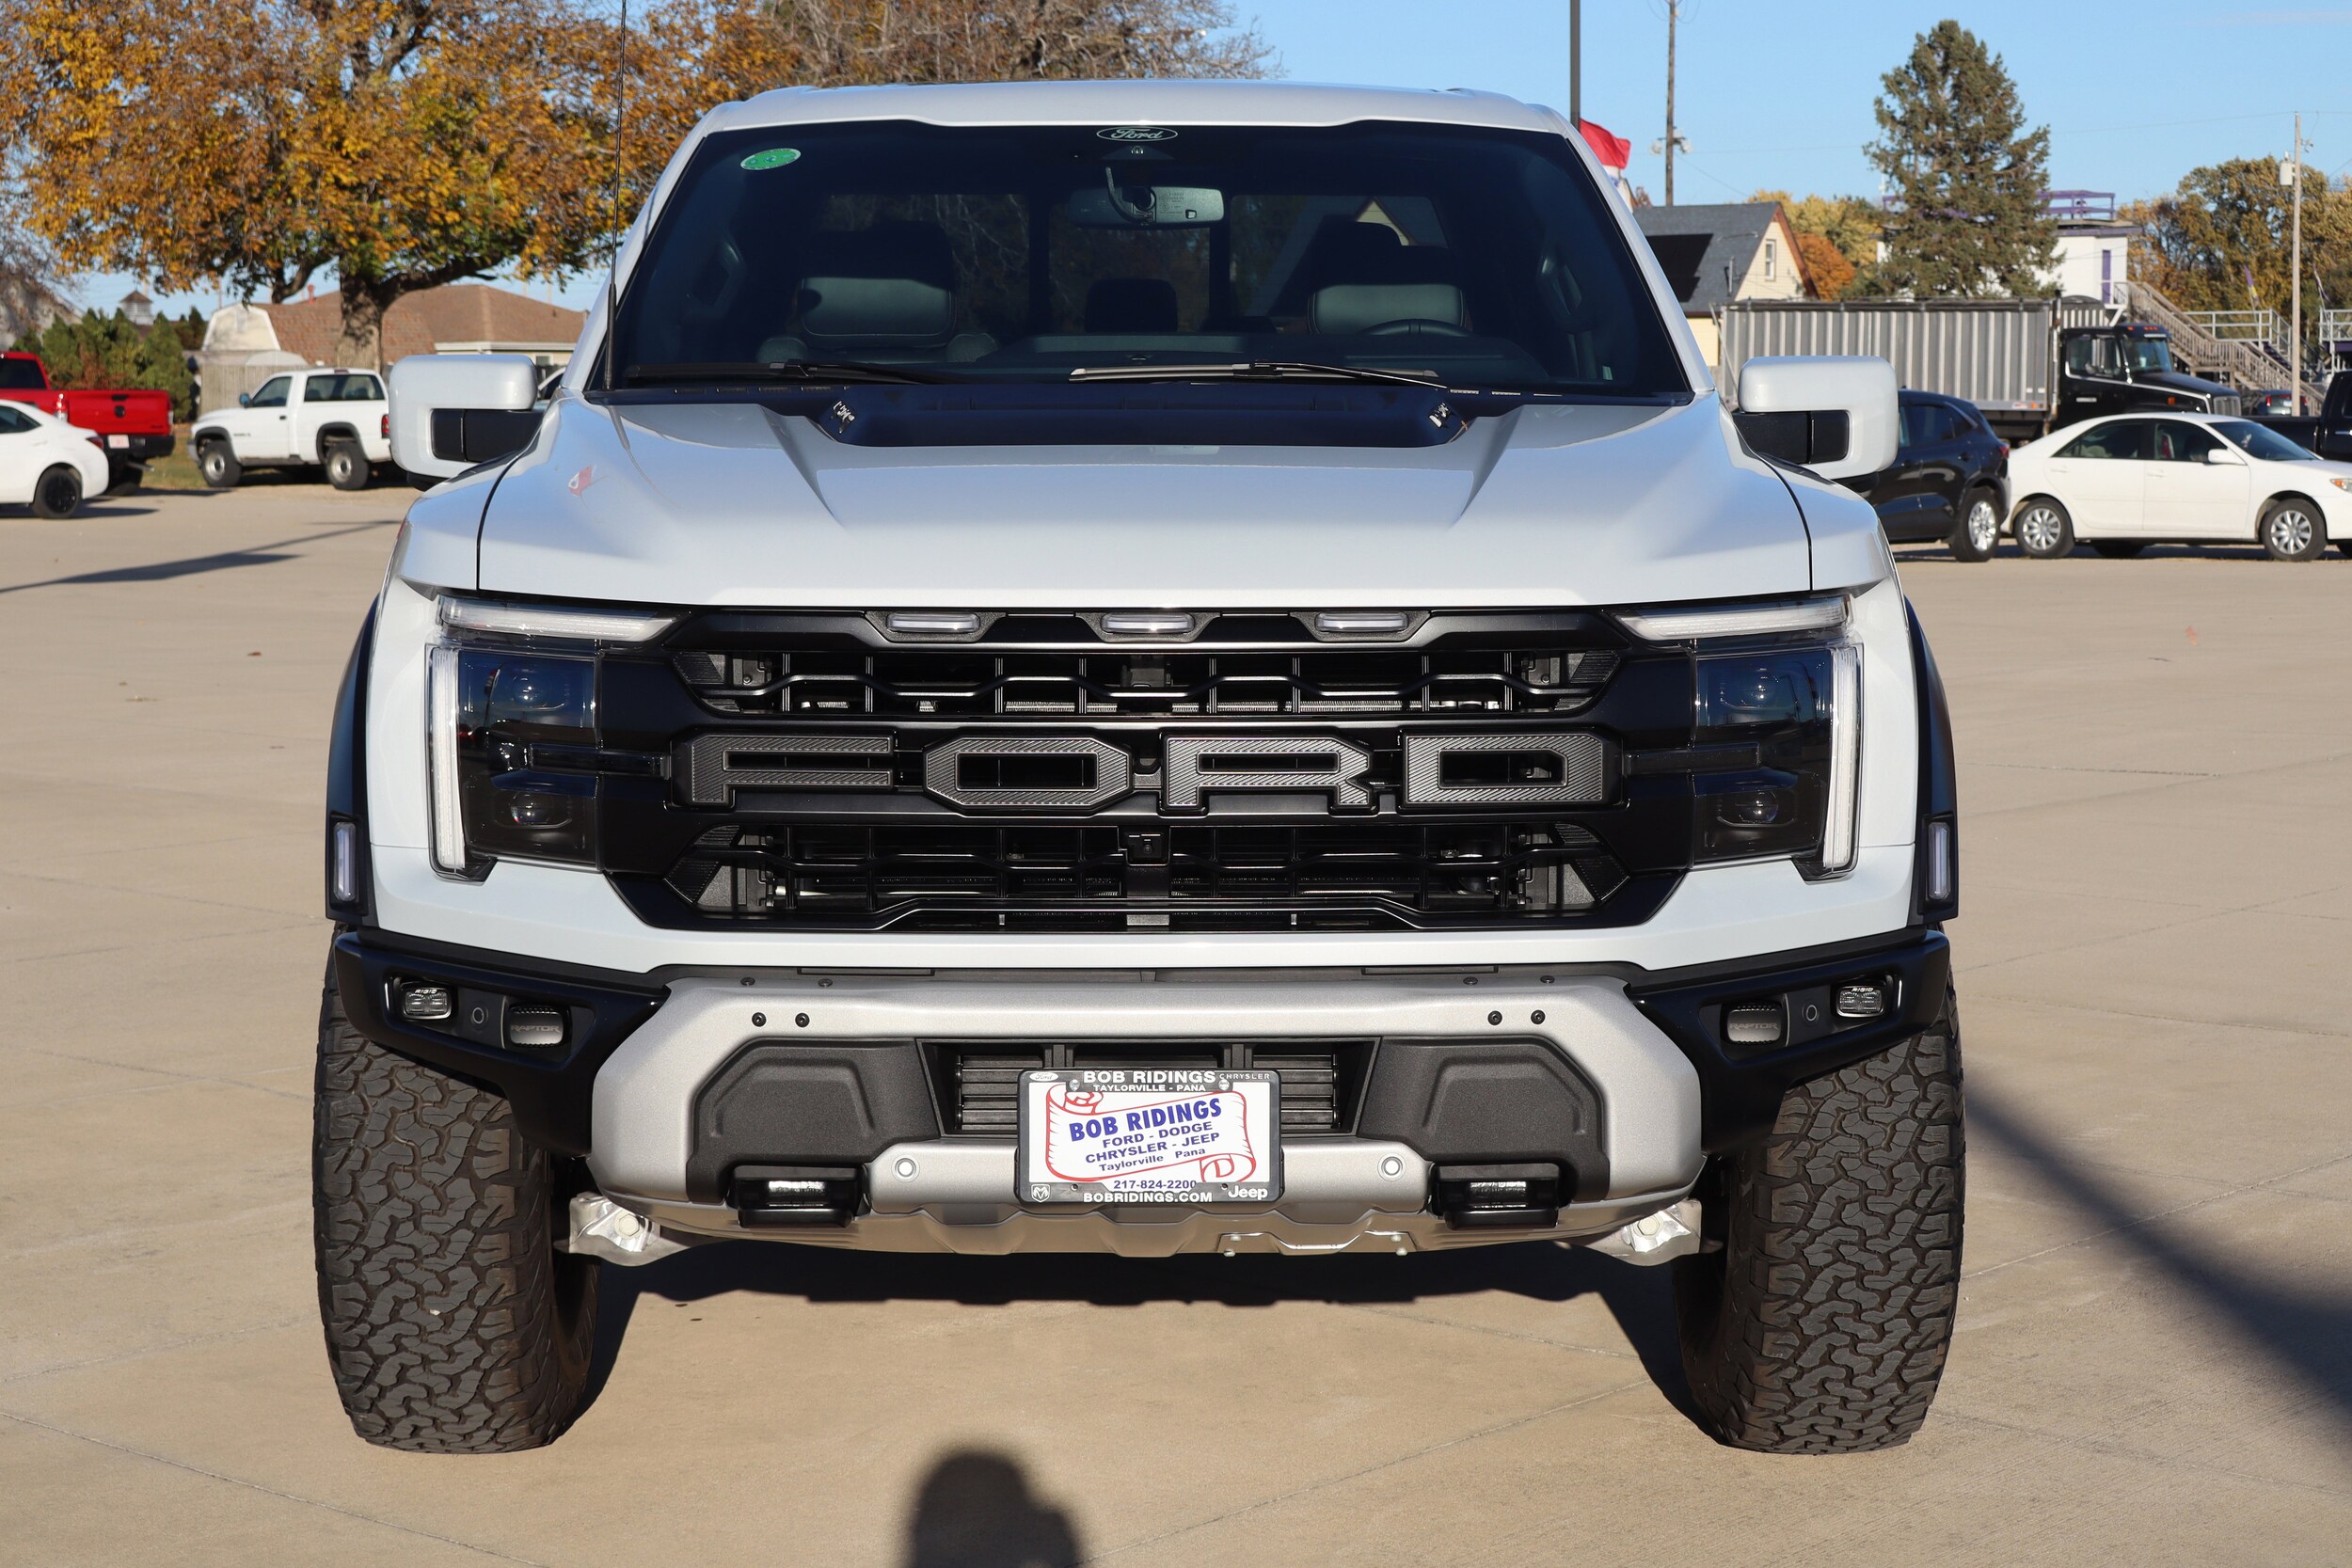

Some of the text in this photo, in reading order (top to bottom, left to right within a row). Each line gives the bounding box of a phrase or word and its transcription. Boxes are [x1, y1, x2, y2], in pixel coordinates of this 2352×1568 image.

[1110, 128, 1163, 139] Ford
[691, 735, 1603, 806] FORD
[511, 1025, 562, 1034] RAPTOR
[1730, 1022, 1779, 1031] RAPTOR
[1083, 1070, 1216, 1084] BOB RIDINGS
[1069, 1098, 1222, 1142] BOB RIDINGS
[1103, 1132, 1144, 1148] FORD
[1158, 1121, 1214, 1139] DODGE
[1085, 1141, 1168, 1164] CHRYSLER
[1182, 1132, 1220, 1147] JEEP
[1099, 1148, 1206, 1172] Taylorville Pana
[1113, 1180, 1197, 1189] 217-824-2200
[1083, 1192, 1213, 1203] BOBRIDINGS.COM
[1228, 1185, 1268, 1200] Jeep
